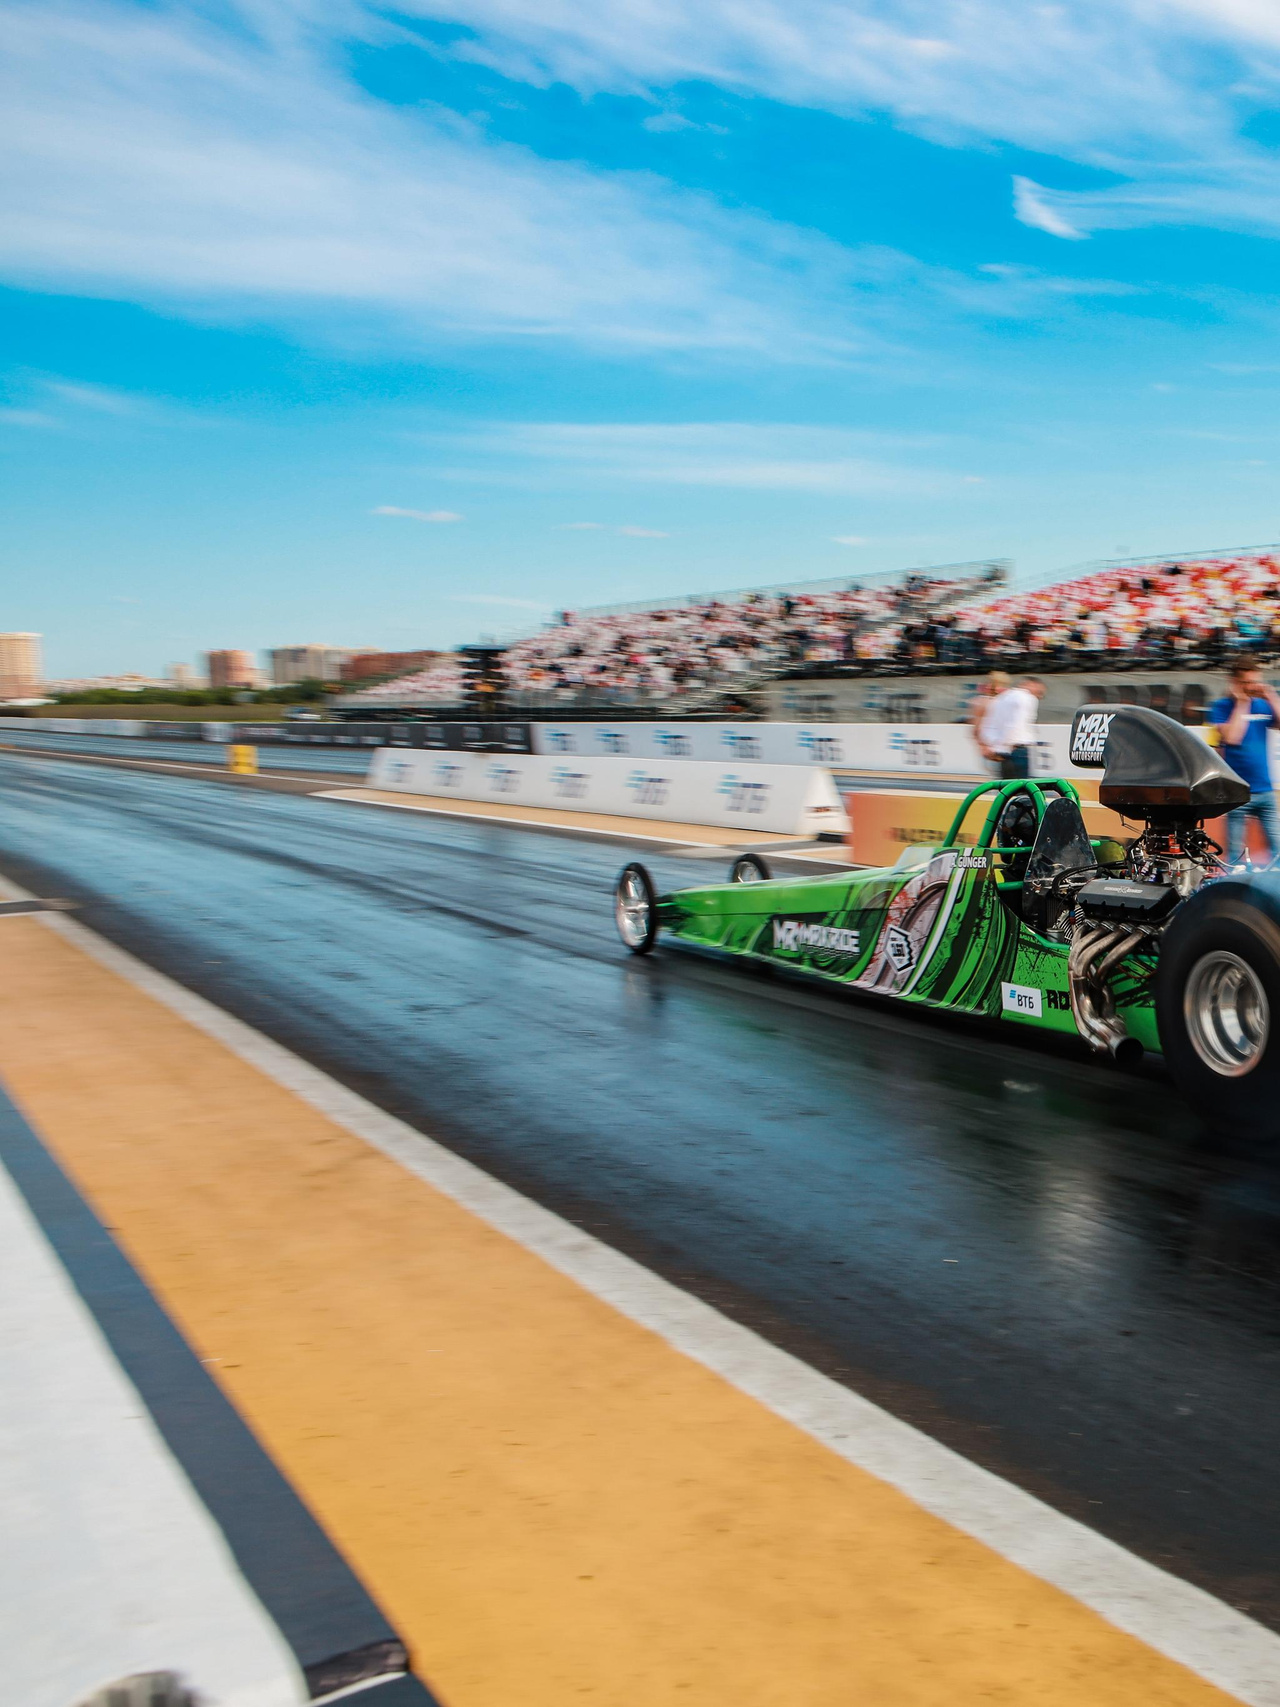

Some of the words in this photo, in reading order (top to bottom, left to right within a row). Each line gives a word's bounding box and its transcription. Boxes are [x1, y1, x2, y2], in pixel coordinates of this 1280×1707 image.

[1076, 713, 1116, 733] MAX
[1071, 750, 1103, 761] MOTORSPORT
[1017, 994, 1034, 1009] ВТБ
[1046, 988, 1072, 1011] RD
